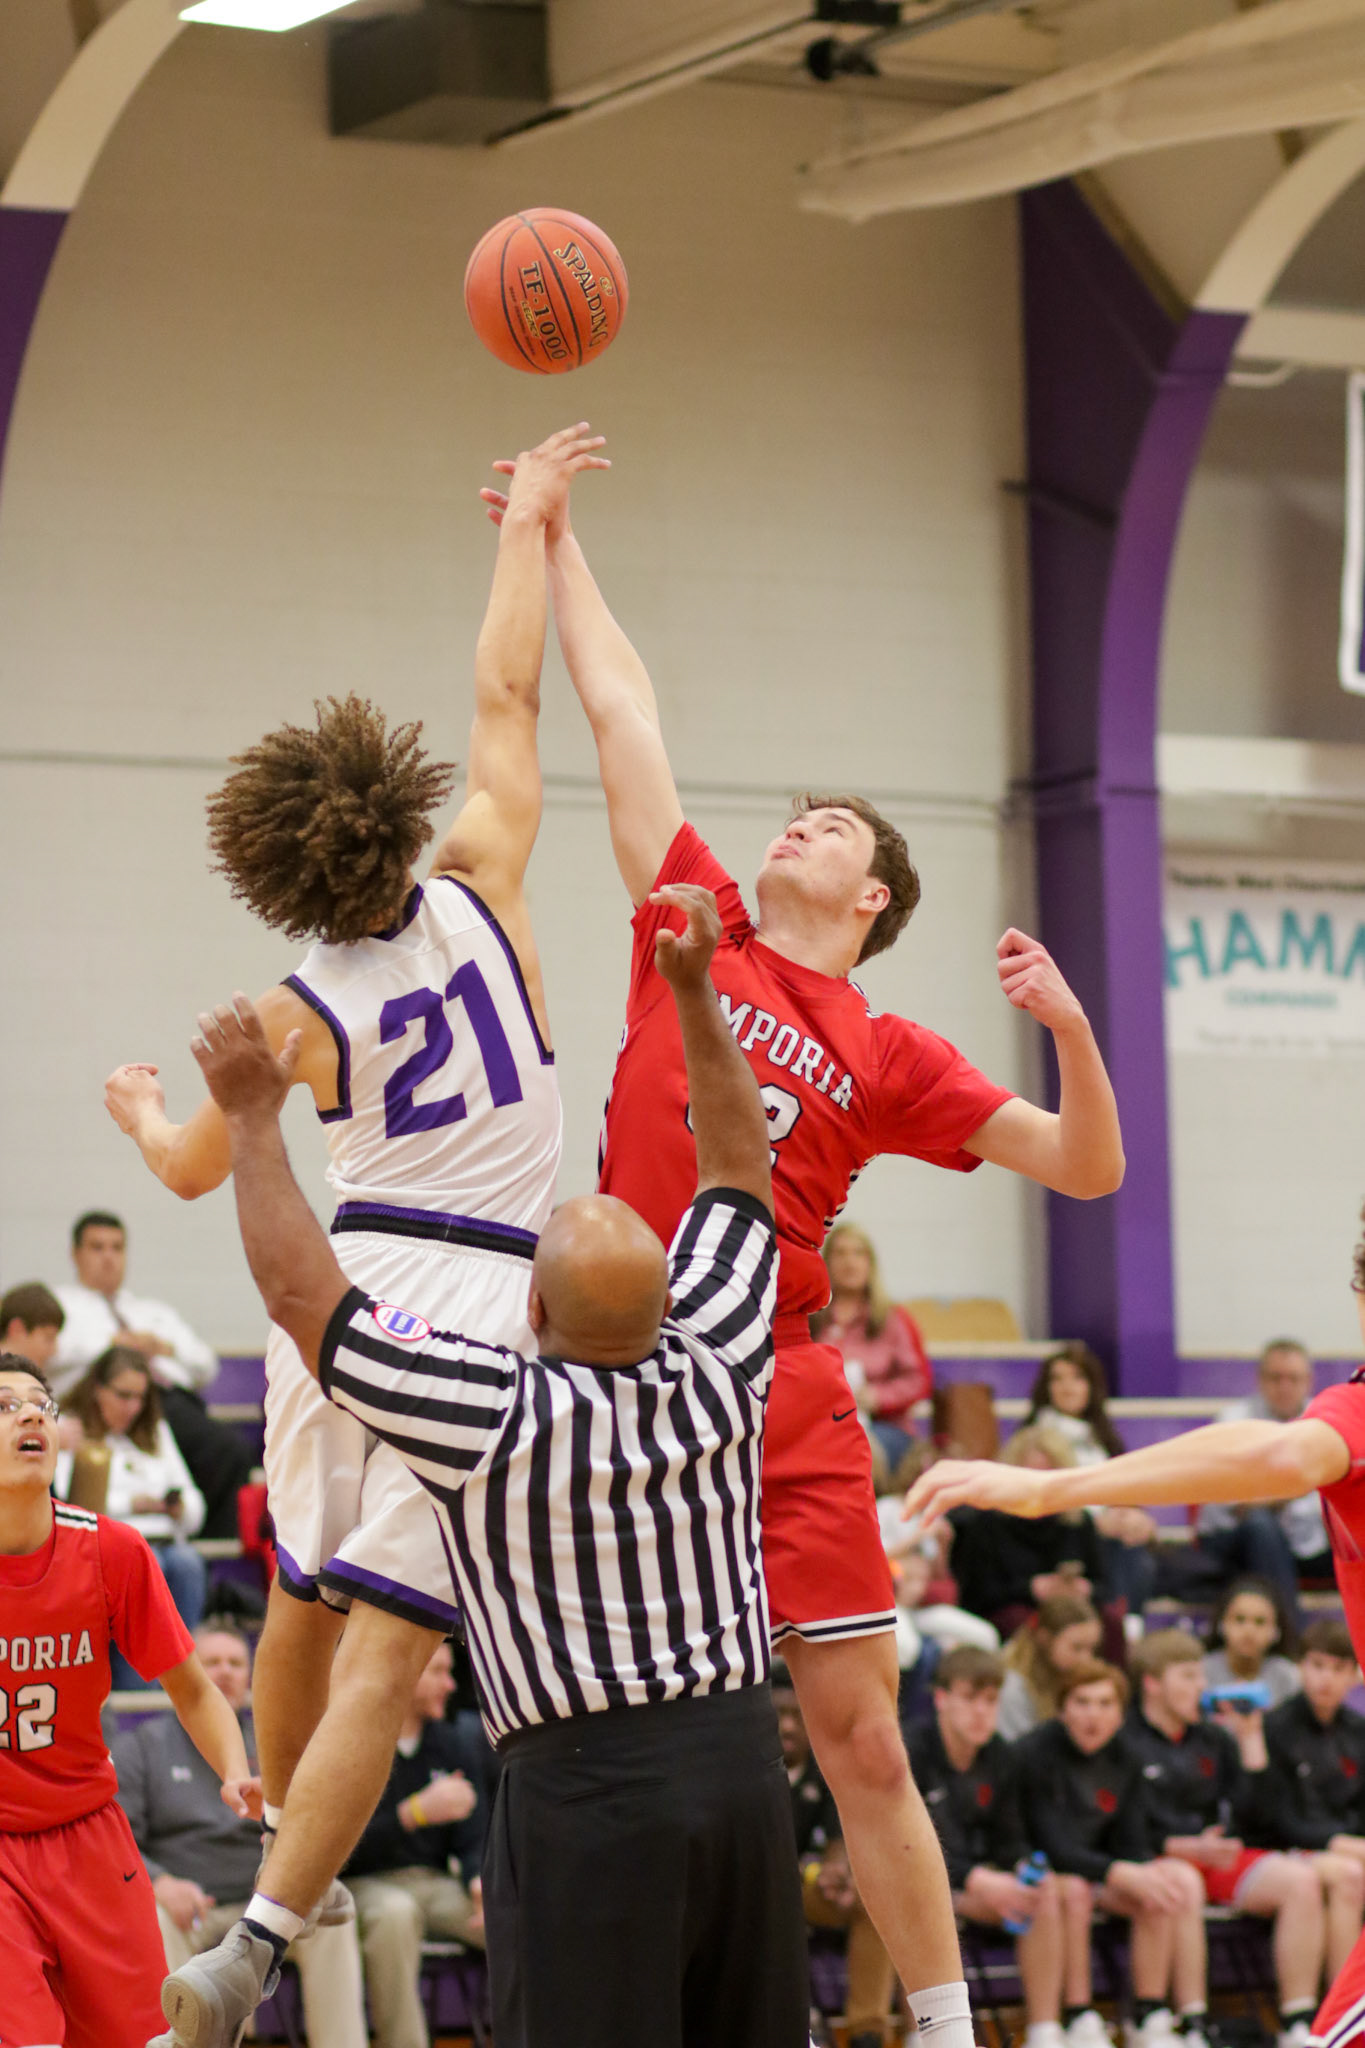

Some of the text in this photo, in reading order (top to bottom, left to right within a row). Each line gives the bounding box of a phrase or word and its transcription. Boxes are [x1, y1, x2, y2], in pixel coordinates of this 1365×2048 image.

[553, 241, 608, 348] SPALDING
[379, 959, 523, 1139] 21
[714, 990, 853, 1112] MPORIA
[0, 1682, 58, 1752] 2
